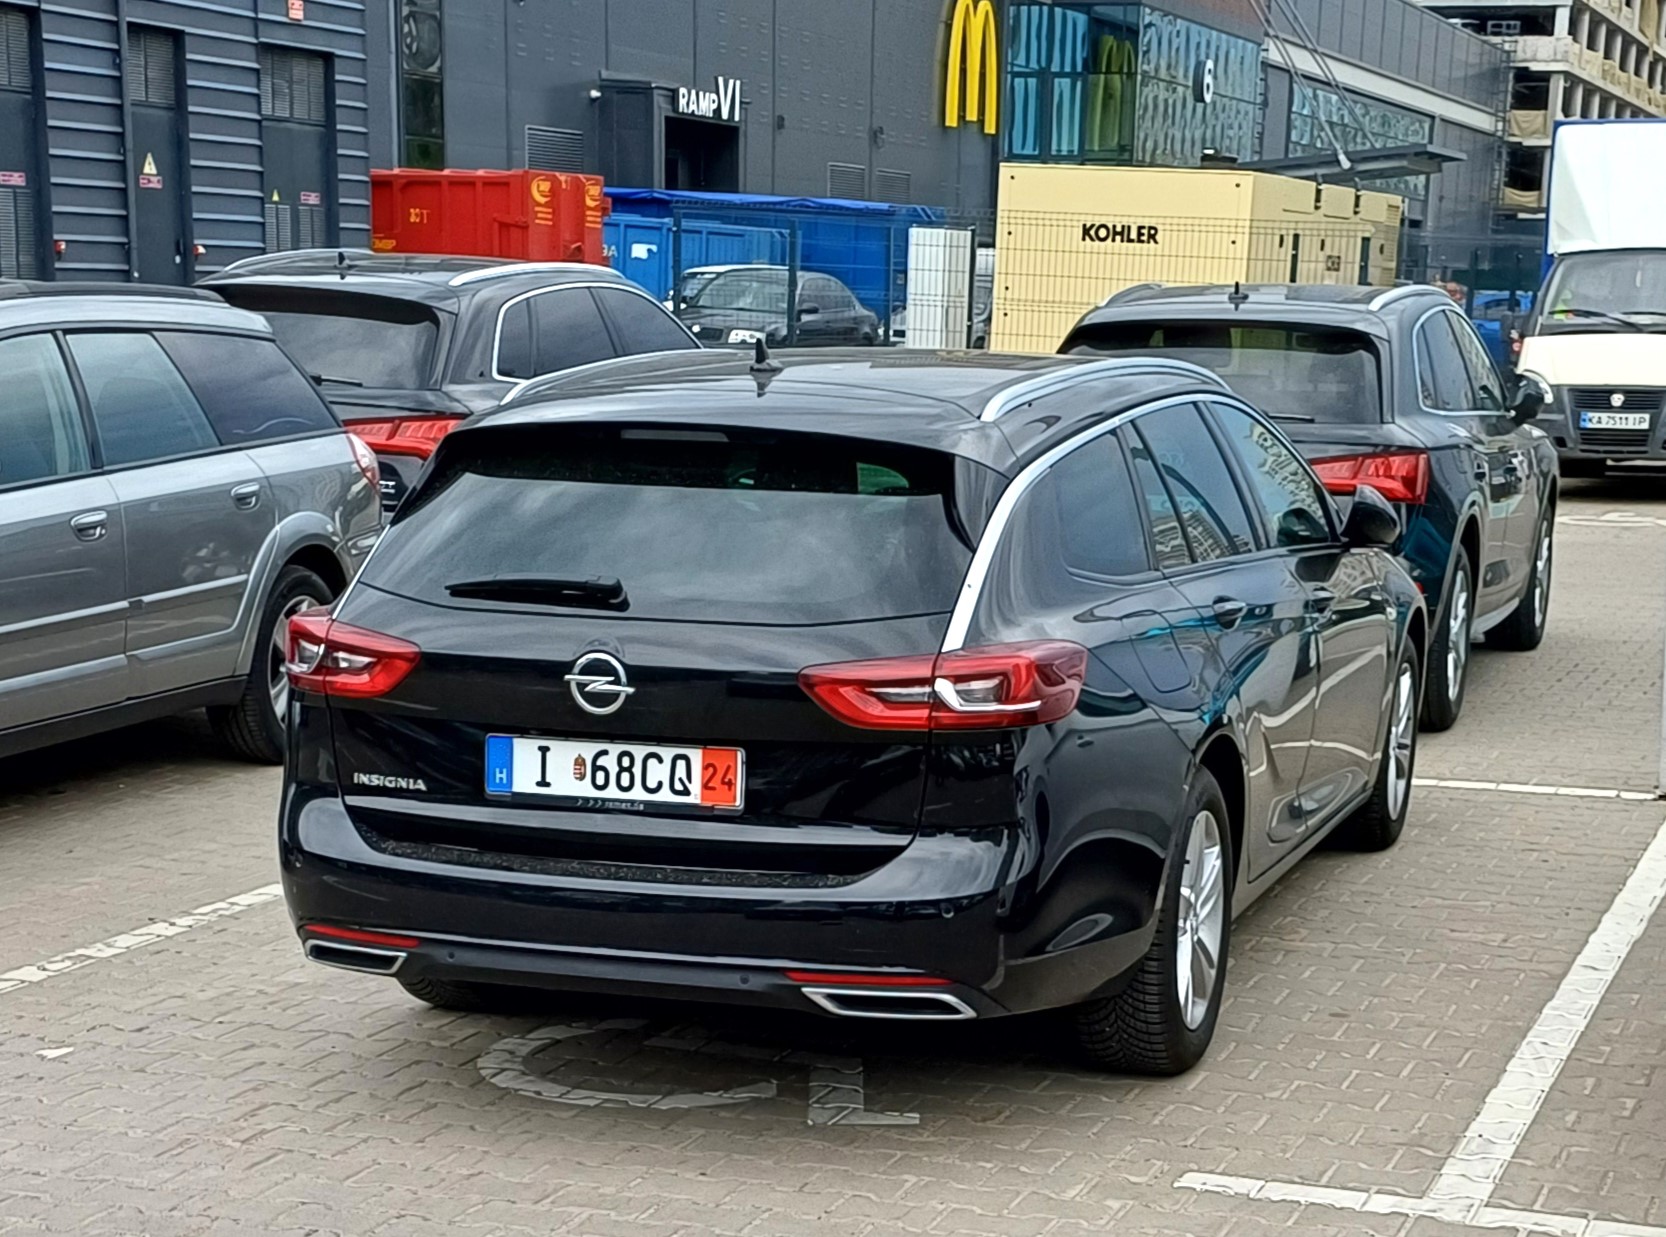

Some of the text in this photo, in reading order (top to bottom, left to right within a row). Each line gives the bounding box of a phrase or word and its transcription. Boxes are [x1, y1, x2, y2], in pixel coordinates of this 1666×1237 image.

[1203, 59, 1214, 104] 6
[679, 76, 741, 122] RAMP VI
[1081, 223, 1159, 244] KOHLER
[1606, 415, 1629, 426] 7511
[353, 772, 428, 791] INSIGNIA
[495, 768, 507, 784] H
[535, 745, 693, 797] I 68CQ
[702, 762, 735, 792] 24
